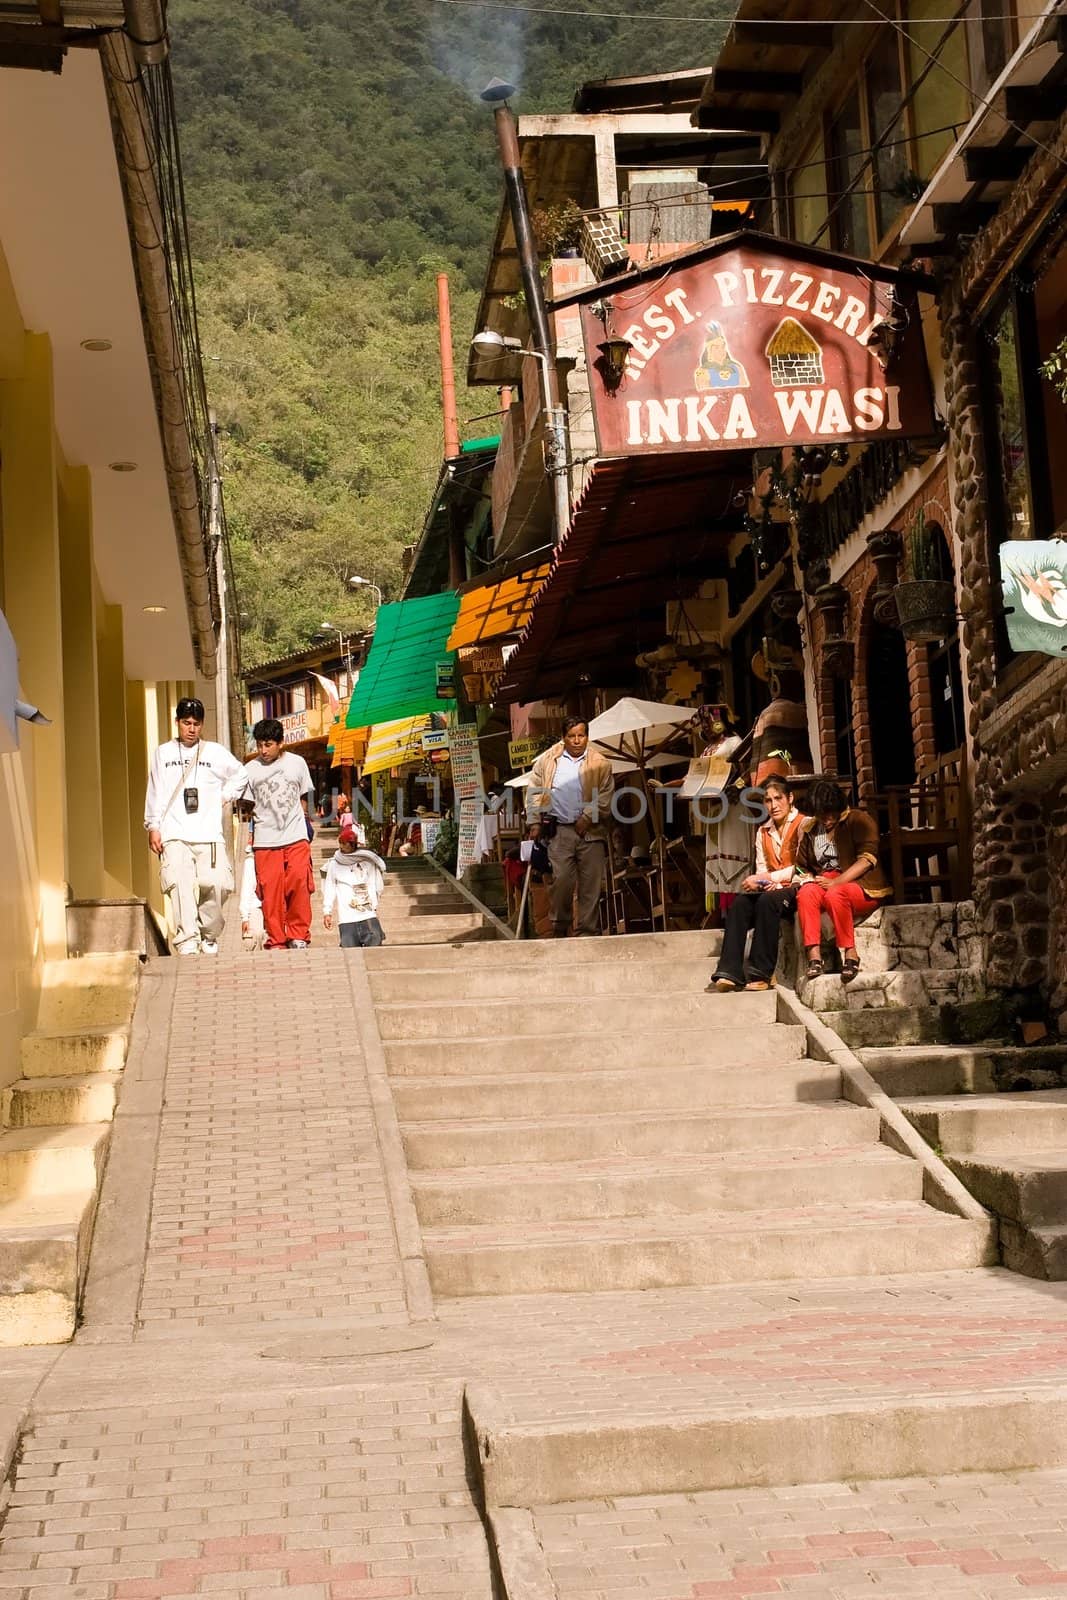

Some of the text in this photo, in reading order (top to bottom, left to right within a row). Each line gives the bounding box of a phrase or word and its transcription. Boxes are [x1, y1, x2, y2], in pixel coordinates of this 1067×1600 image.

[626, 385, 902, 445] INKA WASI
[428, 736, 442, 744] VISA
[165, 759, 211, 768] FALCNS
